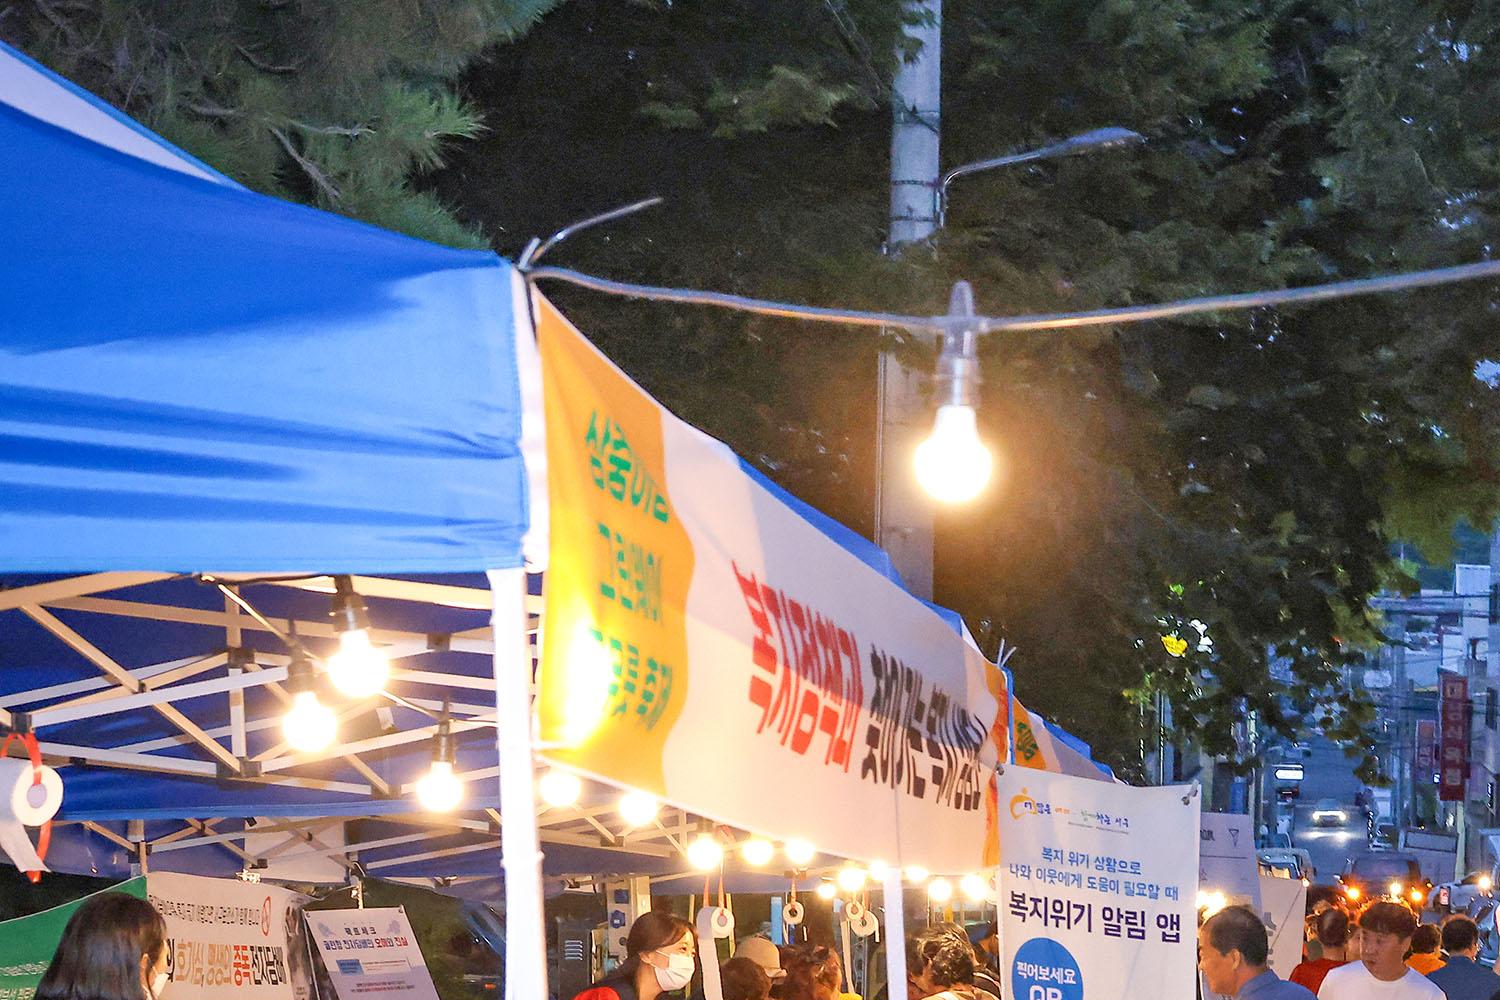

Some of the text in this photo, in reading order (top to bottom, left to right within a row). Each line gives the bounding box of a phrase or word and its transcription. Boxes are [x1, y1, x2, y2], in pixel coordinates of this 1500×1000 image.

[861, 642, 927, 799] 찾아가는
[1041, 847, 1141, 875] 복지 위기 상황으로
[1009, 863, 1179, 901] 나와 이웃에게 도움이 필요할 때
[1008, 890, 1181, 943] 복지위기 알림 앱
[394, 936, 408, 947] 진실
[207, 943, 232, 985] 평생의
[233, 945, 251, 987] 중독
[250, 945, 288, 985] 전자담배
[1017, 961, 1077, 985] 찍어보세요
